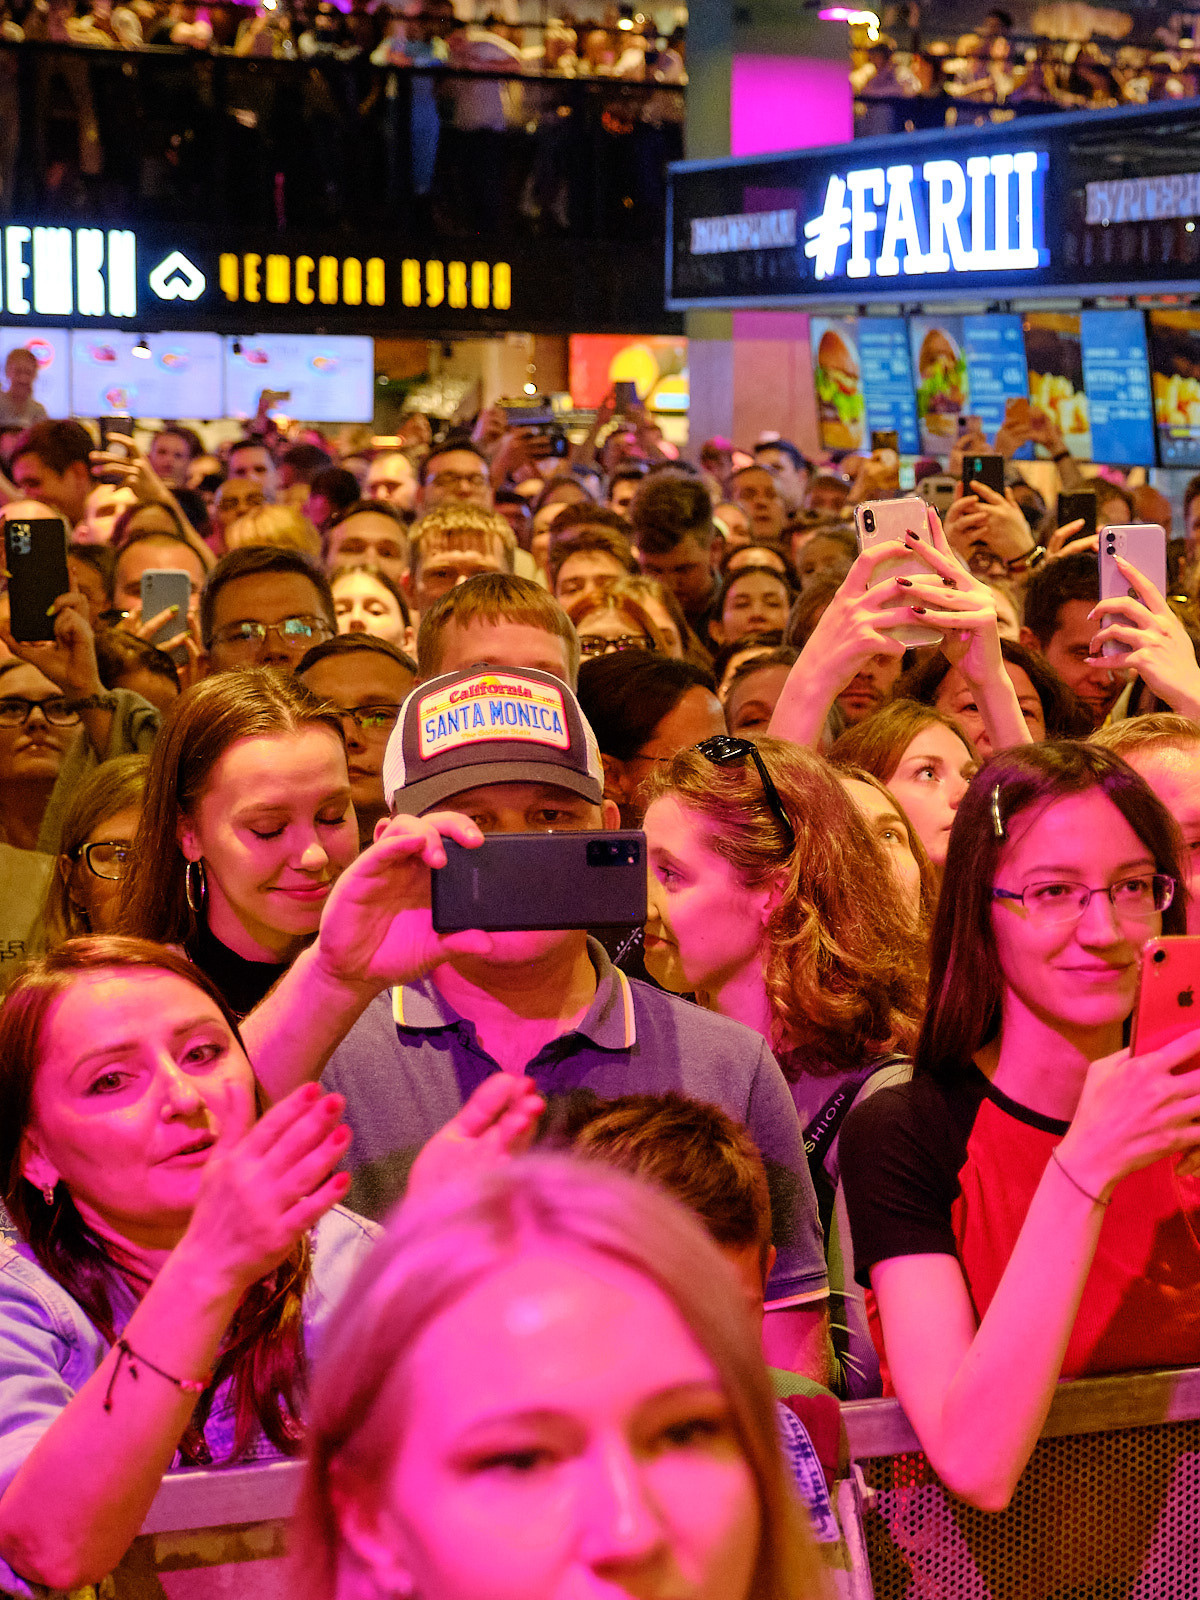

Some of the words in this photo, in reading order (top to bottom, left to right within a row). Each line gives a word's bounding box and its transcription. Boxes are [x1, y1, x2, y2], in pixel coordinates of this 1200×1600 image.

[0, 226, 137, 318] ЕШКИ
[449, 682, 532, 704] California
[425, 702, 485, 743] SANTA
[489, 700, 563, 736] MONICA
[804, 1093, 845, 1154] SHION
